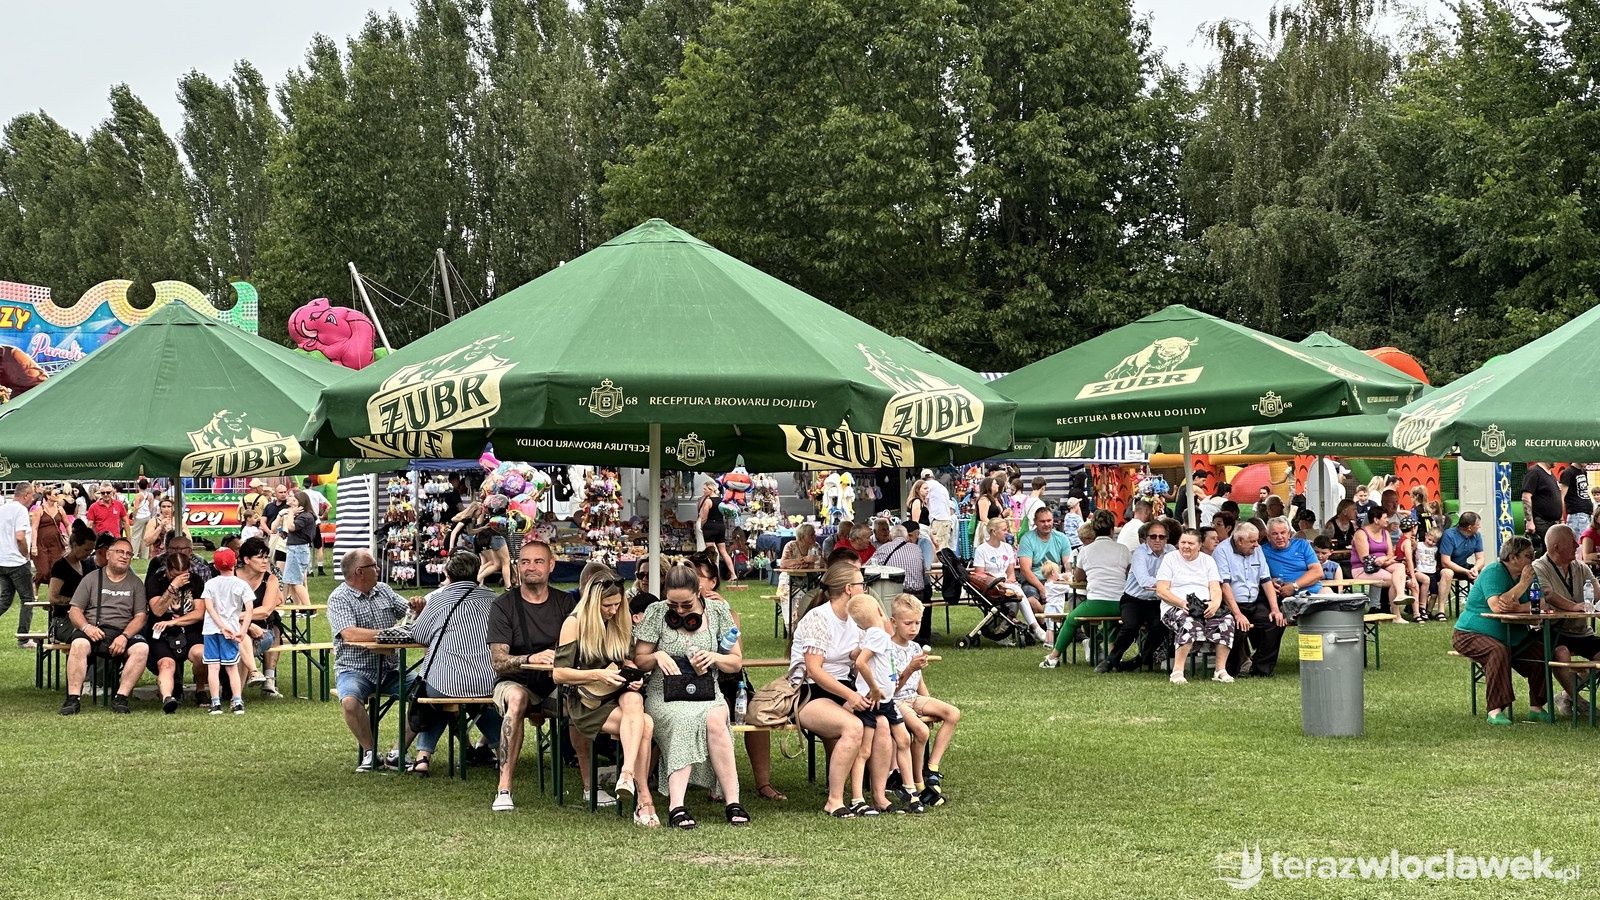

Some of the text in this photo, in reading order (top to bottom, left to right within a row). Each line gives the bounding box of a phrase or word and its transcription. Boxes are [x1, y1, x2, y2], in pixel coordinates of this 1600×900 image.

[578, 397, 588, 406] 17
[625, 396, 638, 405] 68
[649, 396, 712, 406] RECEPTURA
[714, 397, 770, 407] BROWARU
[772, 398, 817, 409] DOJLIDY
[1056, 413, 1108, 425] RECEPTURA
[1110, 410, 1161, 421] BROWARU
[1164, 407, 1207, 417] DOJLIDY
[1283, 401, 1292, 409] 68
[1473, 439, 1480, 447] 17
[1507, 438, 1517, 447] 68
[1525, 439, 1573, 447] RECEPTURA
[98, 461, 124, 469] DOJLIDY
